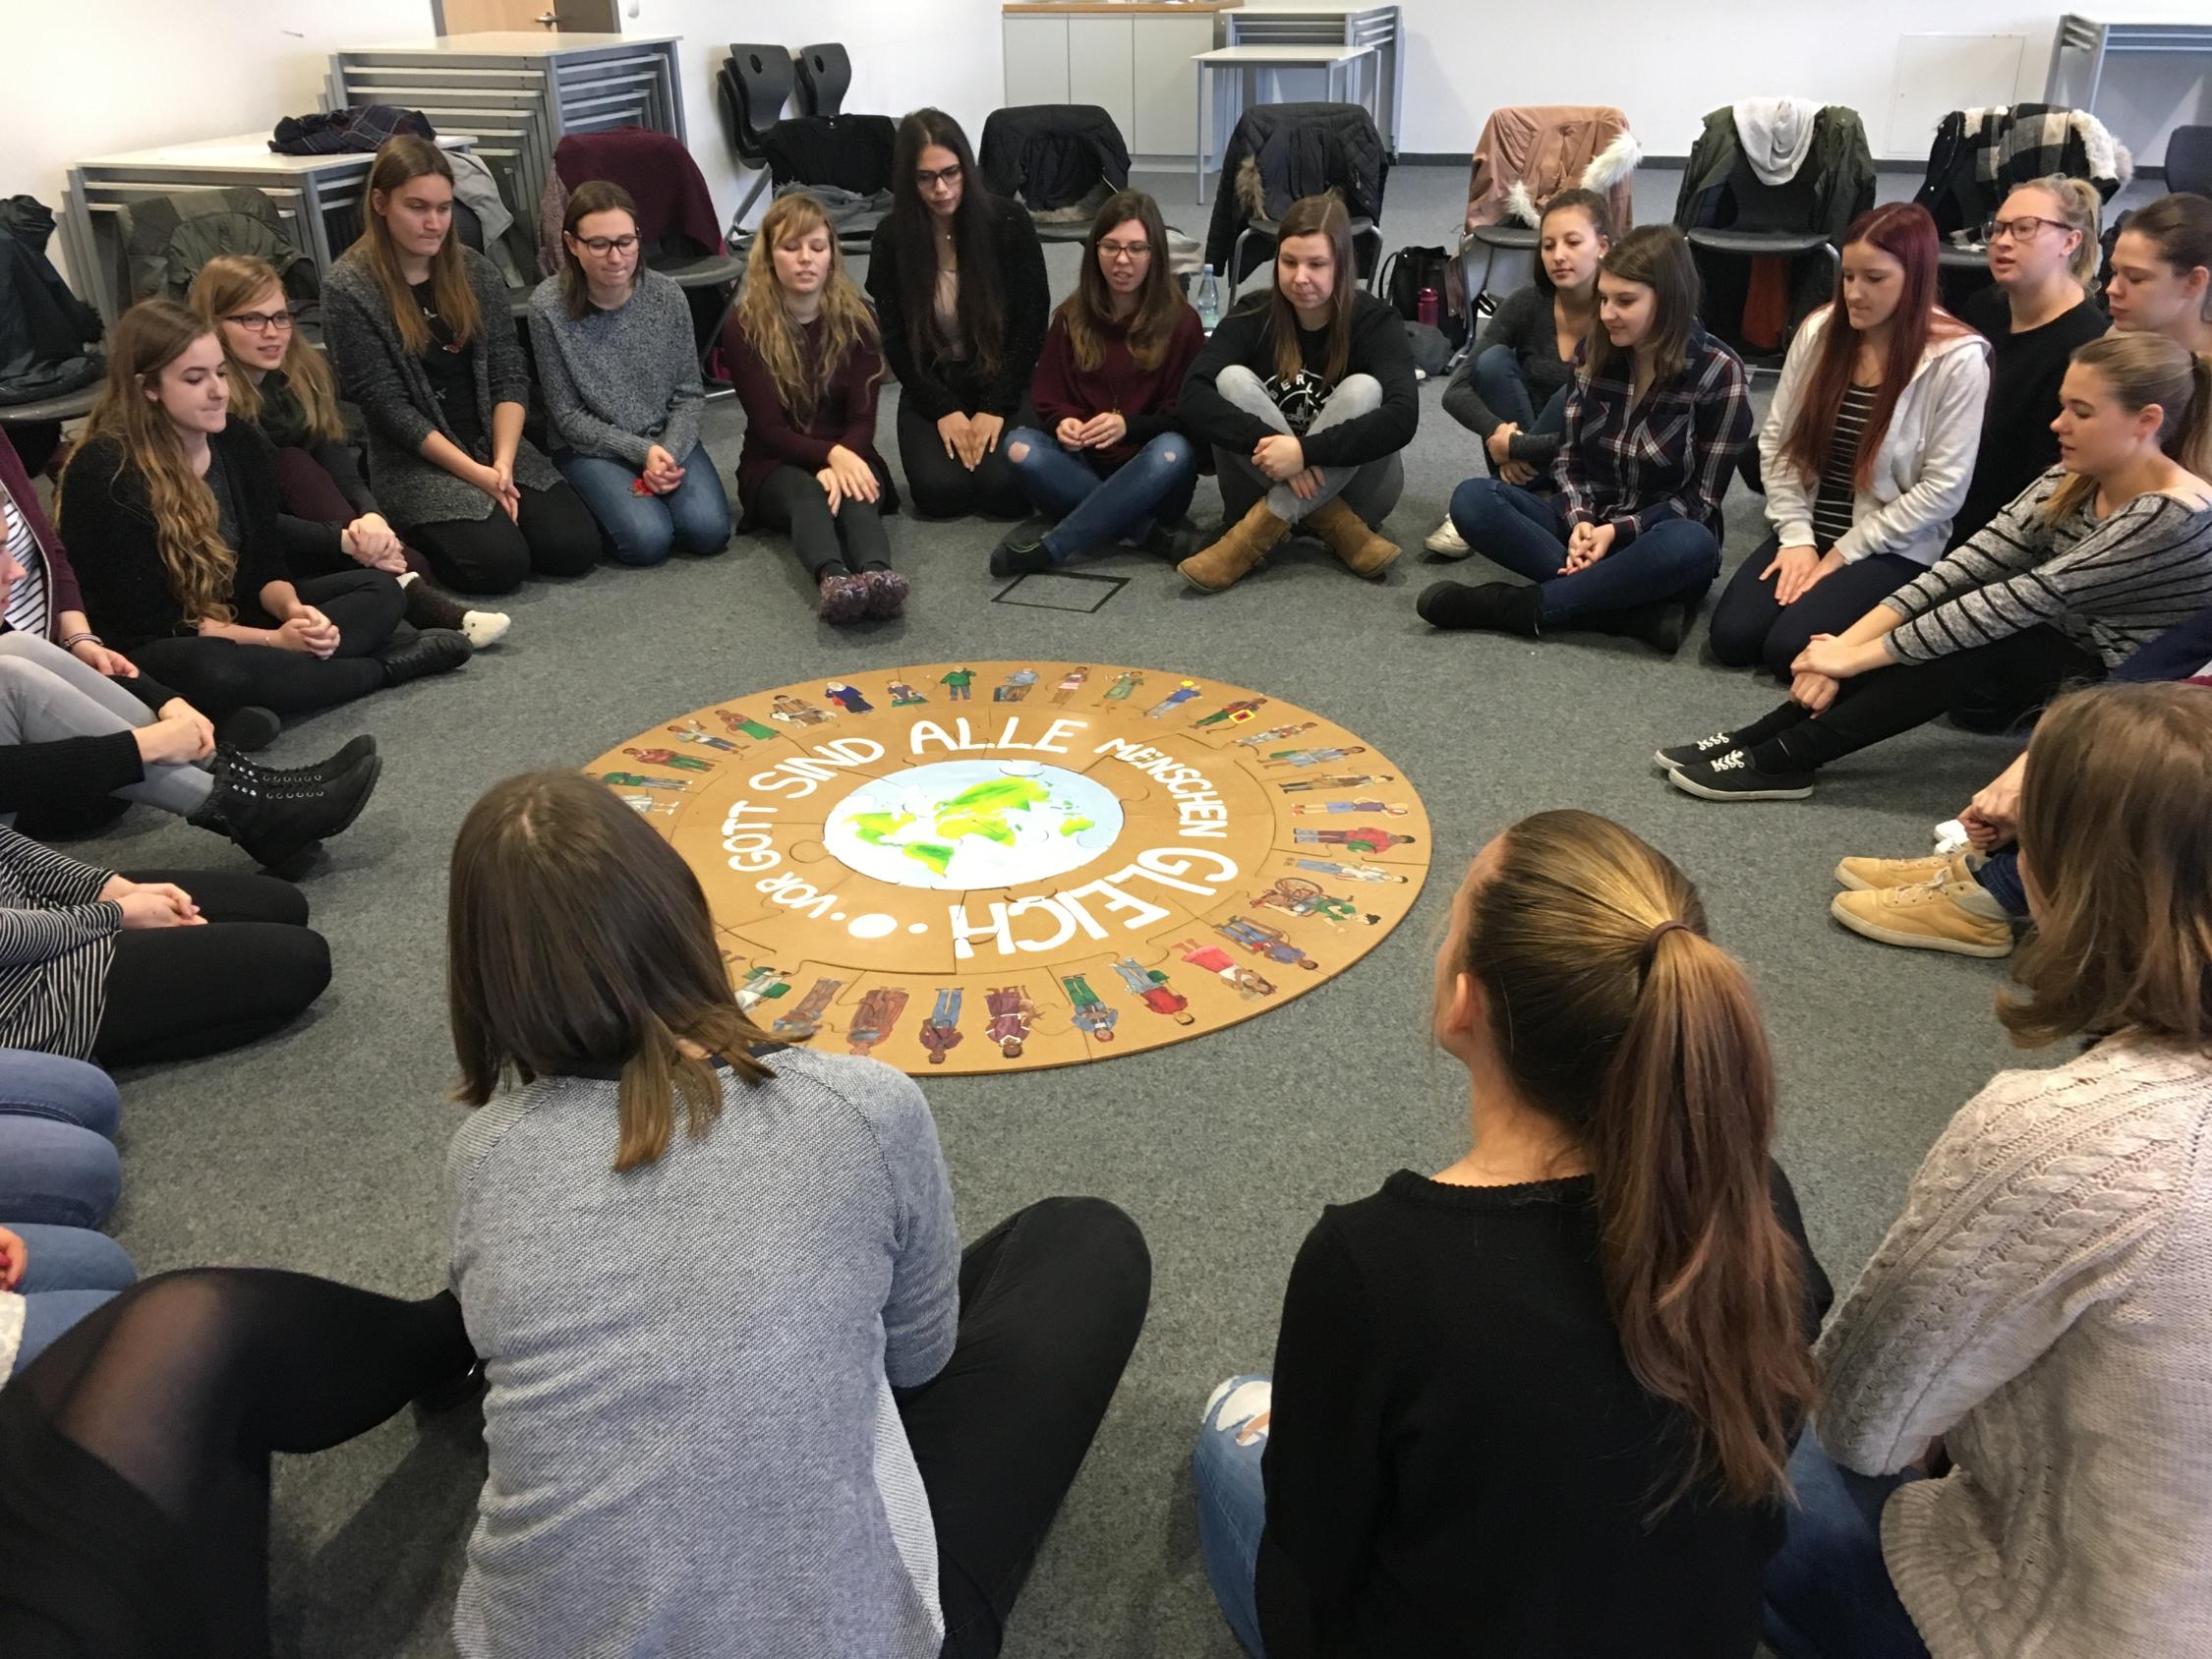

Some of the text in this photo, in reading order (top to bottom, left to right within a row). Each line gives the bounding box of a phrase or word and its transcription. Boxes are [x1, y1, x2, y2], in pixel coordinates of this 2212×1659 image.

[723, 716, 1238, 959] VOR GOTT SIND ALLE MENSCHEN GLEICH
